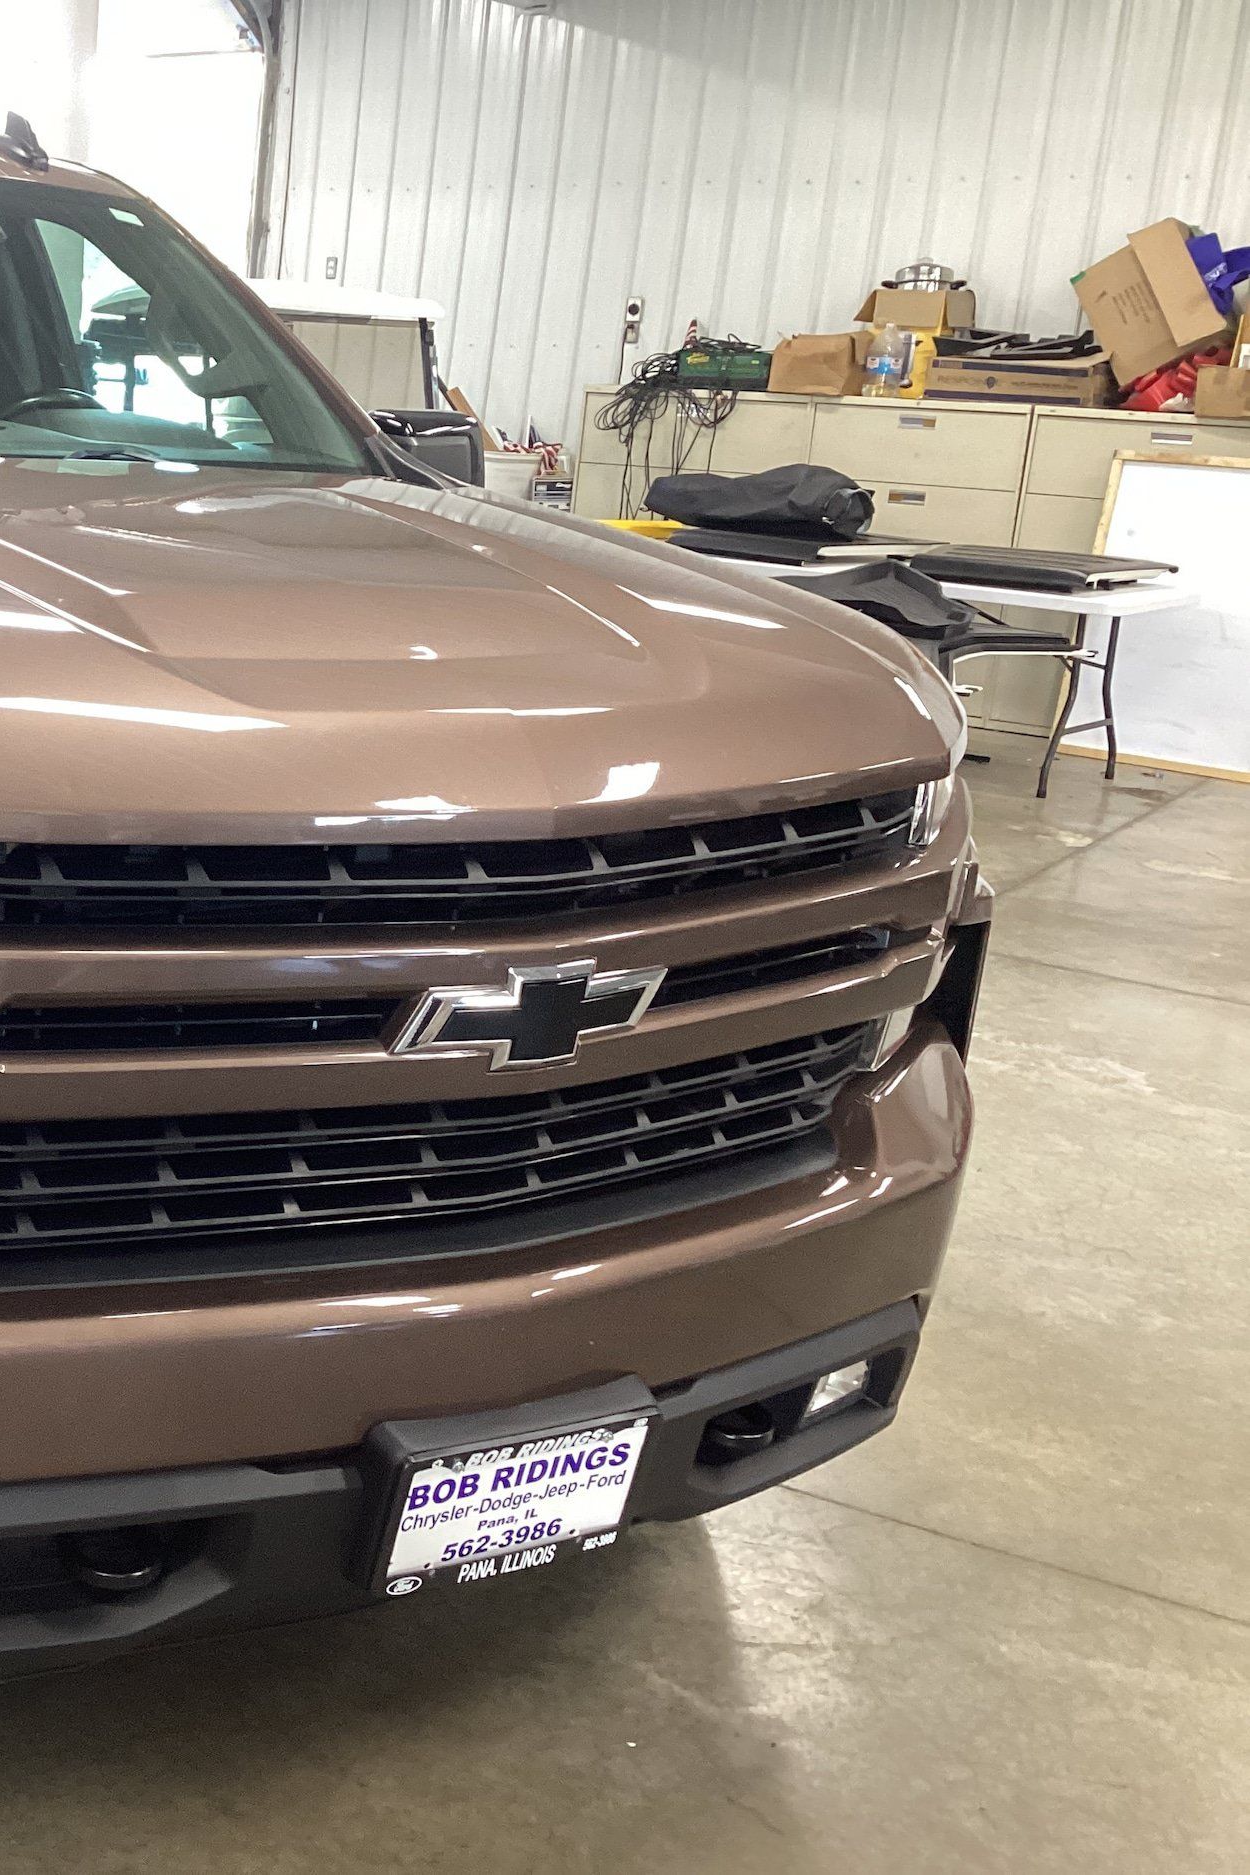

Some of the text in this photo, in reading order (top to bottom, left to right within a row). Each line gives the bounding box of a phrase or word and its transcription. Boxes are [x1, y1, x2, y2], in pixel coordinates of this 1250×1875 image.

[465, 1428, 606, 1469] BOB RIDINGS
[407, 1443, 631, 1511] BOB RIDINGS
[401, 1470, 627, 1532] Chrysler-Dodge-Jeep-Ford
[477, 1508, 538, 1531] Pana, IL
[441, 1518, 563, 1563] 562-3986
[500, 1544, 556, 1574] ILLINOIS
